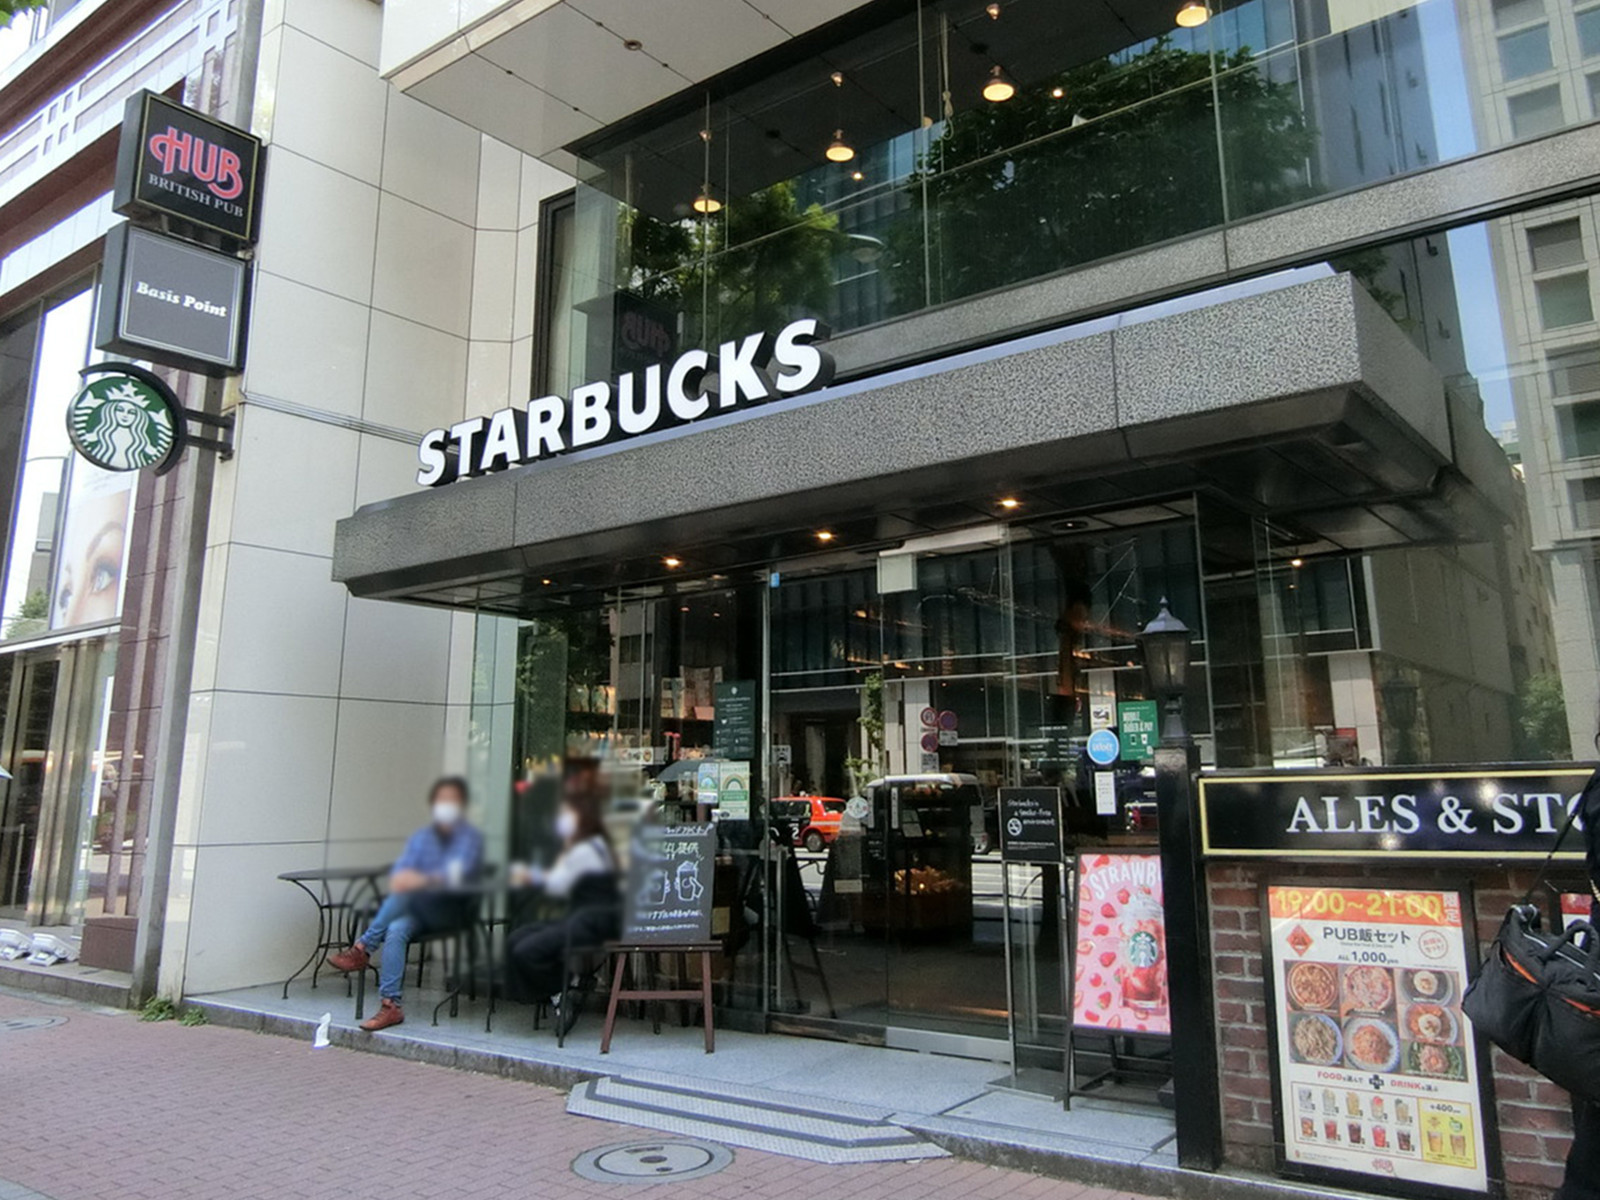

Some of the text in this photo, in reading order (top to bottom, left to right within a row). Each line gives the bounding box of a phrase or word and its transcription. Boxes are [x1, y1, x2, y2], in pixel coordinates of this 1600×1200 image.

[150, 126, 243, 200] HUB
[148, 173, 244, 218] BRITISH PUB
[136, 281, 227, 318] Basis Point
[416, 318, 822, 486] STARBUCKS
[1286, 795, 1420, 834] ALES
[1437, 796, 1477, 834] &
[1323, 927, 1411, 945] PUB飯セット
